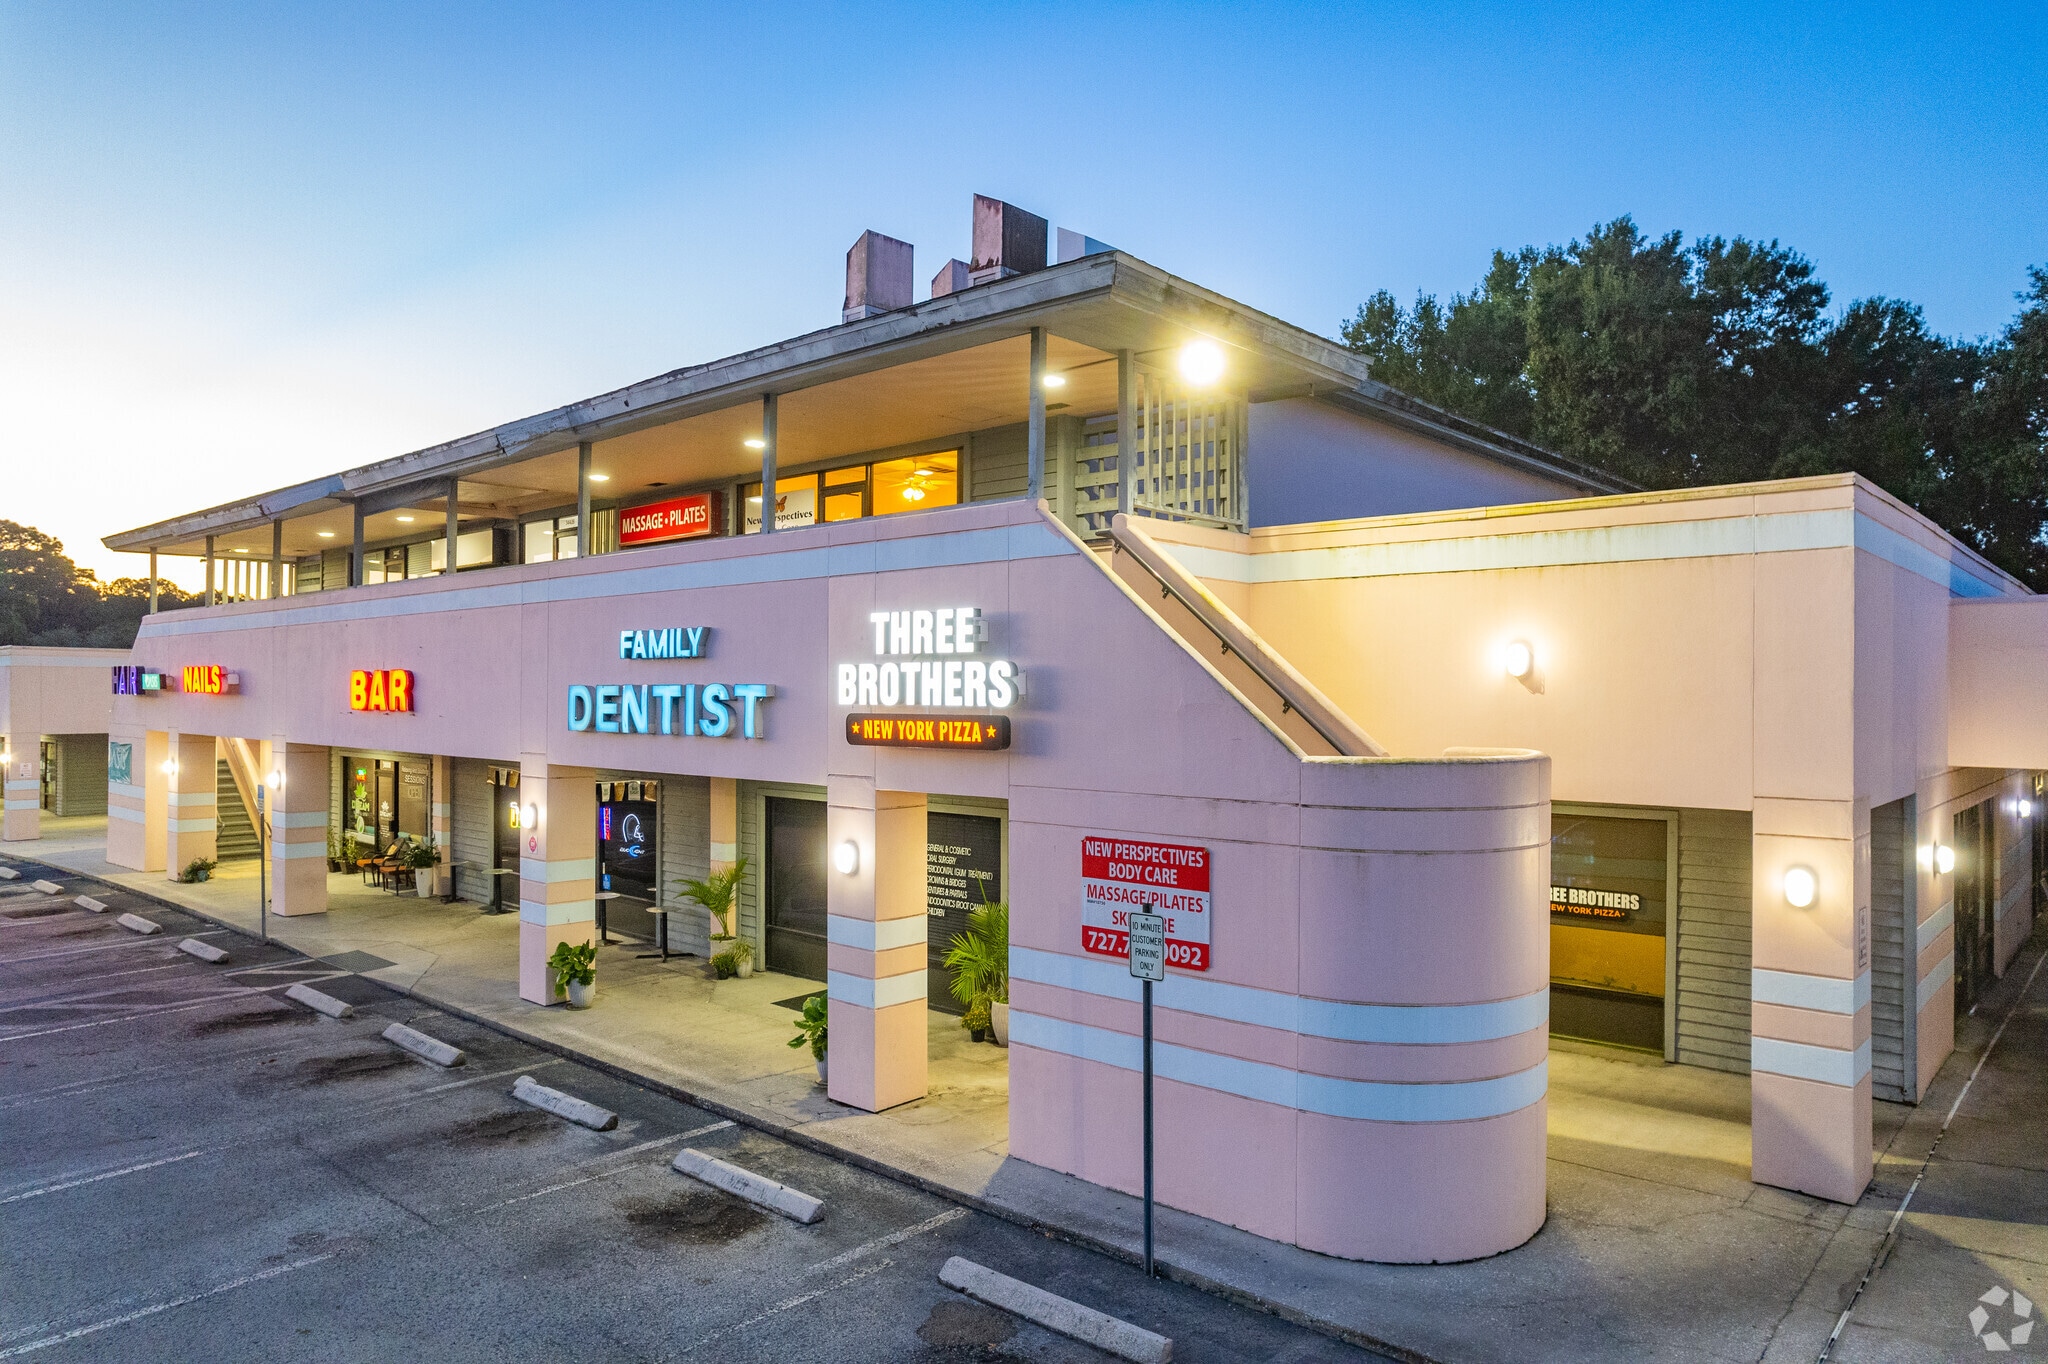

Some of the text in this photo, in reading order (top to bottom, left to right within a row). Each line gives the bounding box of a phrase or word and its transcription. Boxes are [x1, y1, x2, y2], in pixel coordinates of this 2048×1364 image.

[622, 505, 706, 534] MASSAGE PILATES
[775, 510, 813, 522] rspectives
[620, 626, 703, 659] FAMILY
[870, 608, 975, 654] THREE
[112, 666, 138, 695] HAIR
[183, 665, 221, 694] NAILS
[350, 669, 408, 712] BAR
[838, 661, 1013, 707] BROTHERS
[568, 684, 768, 739] DENTIST
[863, 720, 982, 742] NEW YORK PIZZA
[1086, 840, 1204, 868] NEW PERSPECTIVES
[1108, 862, 1178, 884] BODY CARE
[927, 886, 944, 895] ENTURES
[927, 896, 955, 908] NDODONTICS
[1087, 884, 1204, 913] MASSAGE/PILATES
[1569, 888, 1640, 910] BROTHERS
[1550, 904, 1620, 917] EW YORK PIZZA
[1132, 921, 1138, 930] 10
[1140, 923, 1161, 934] MINUTE
[1132, 934, 1162, 946] CUSTOMER
[1088, 930, 1202, 966] 727.7092
[1135, 948, 1159, 959] PARKING
[1140, 961, 1154, 971] ONLY
